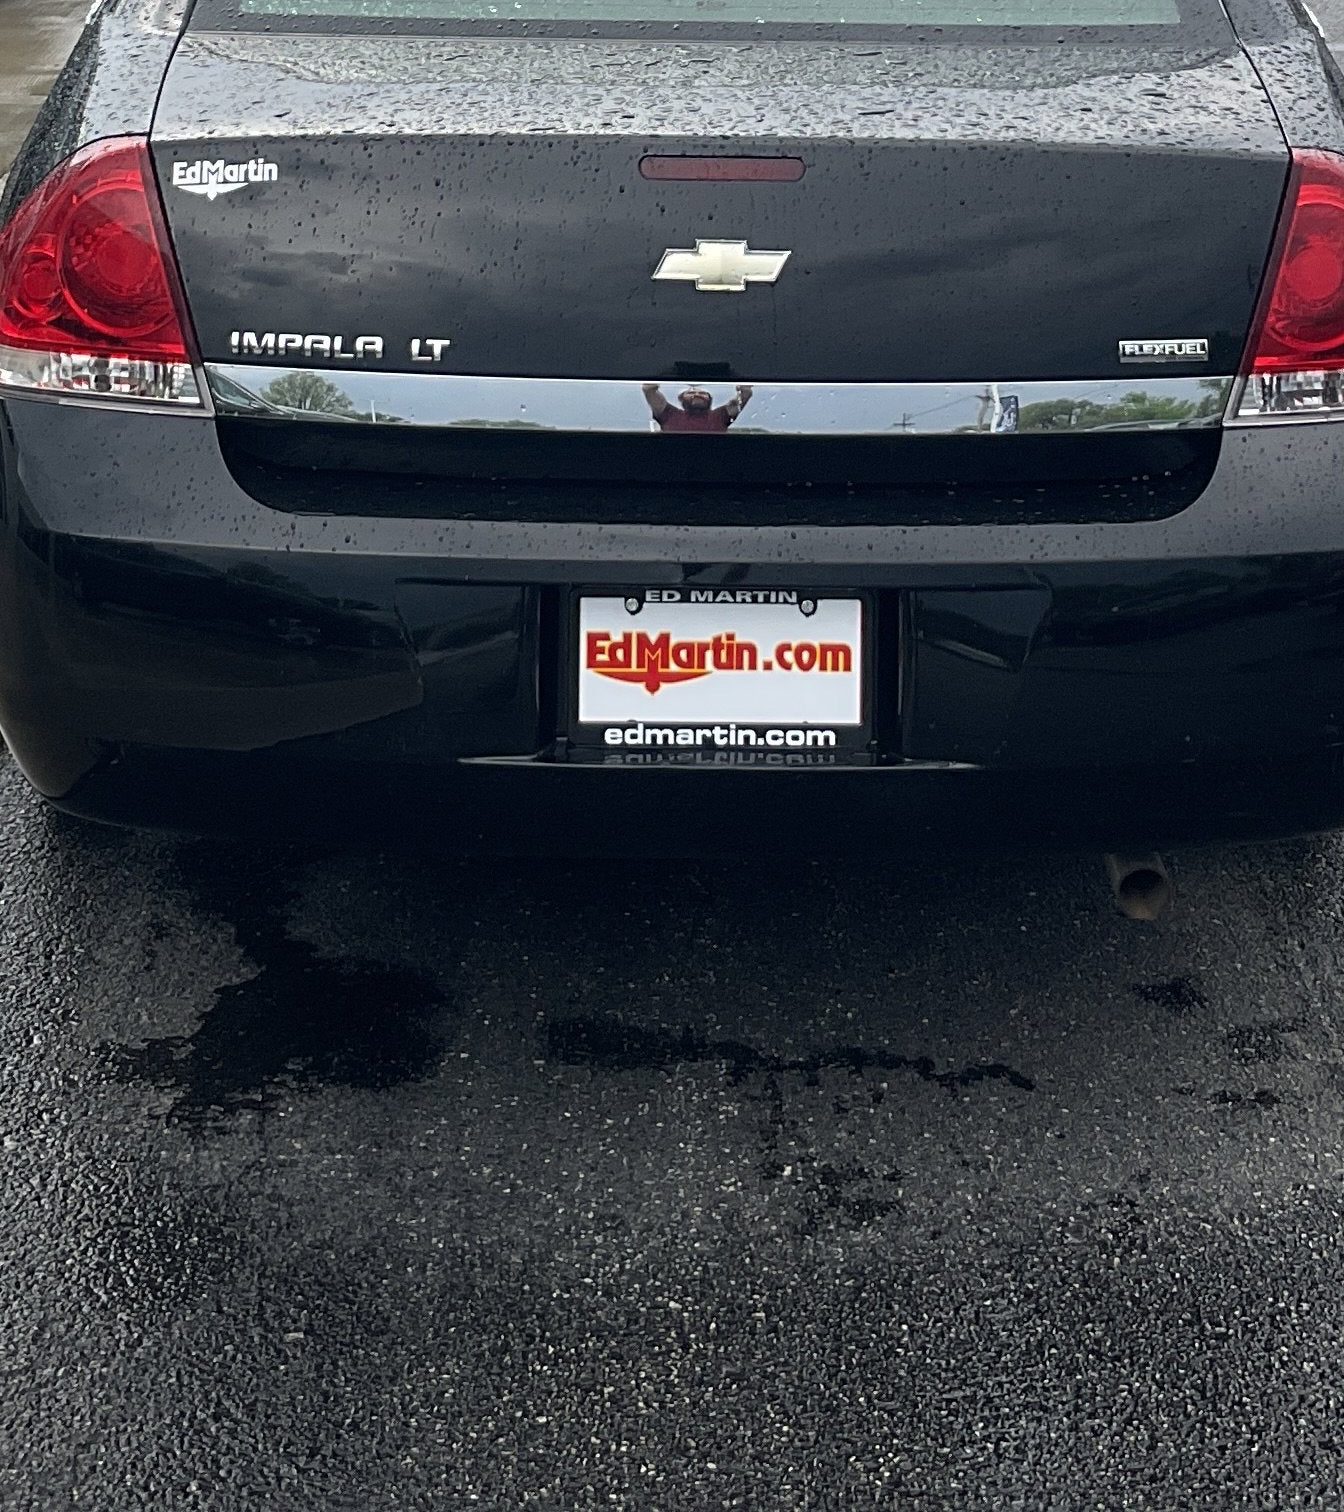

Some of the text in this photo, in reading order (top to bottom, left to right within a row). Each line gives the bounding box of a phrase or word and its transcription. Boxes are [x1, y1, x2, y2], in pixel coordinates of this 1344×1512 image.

[172, 158, 278, 186] EdMartin
[230, 331, 451, 362] IMPALA LT
[1124, 343, 1206, 356] FLEXFUEL
[645, 590, 798, 603] ED MARTIN
[586, 632, 852, 673] EdMartin.com
[604, 723, 836, 746] edmartin.com
